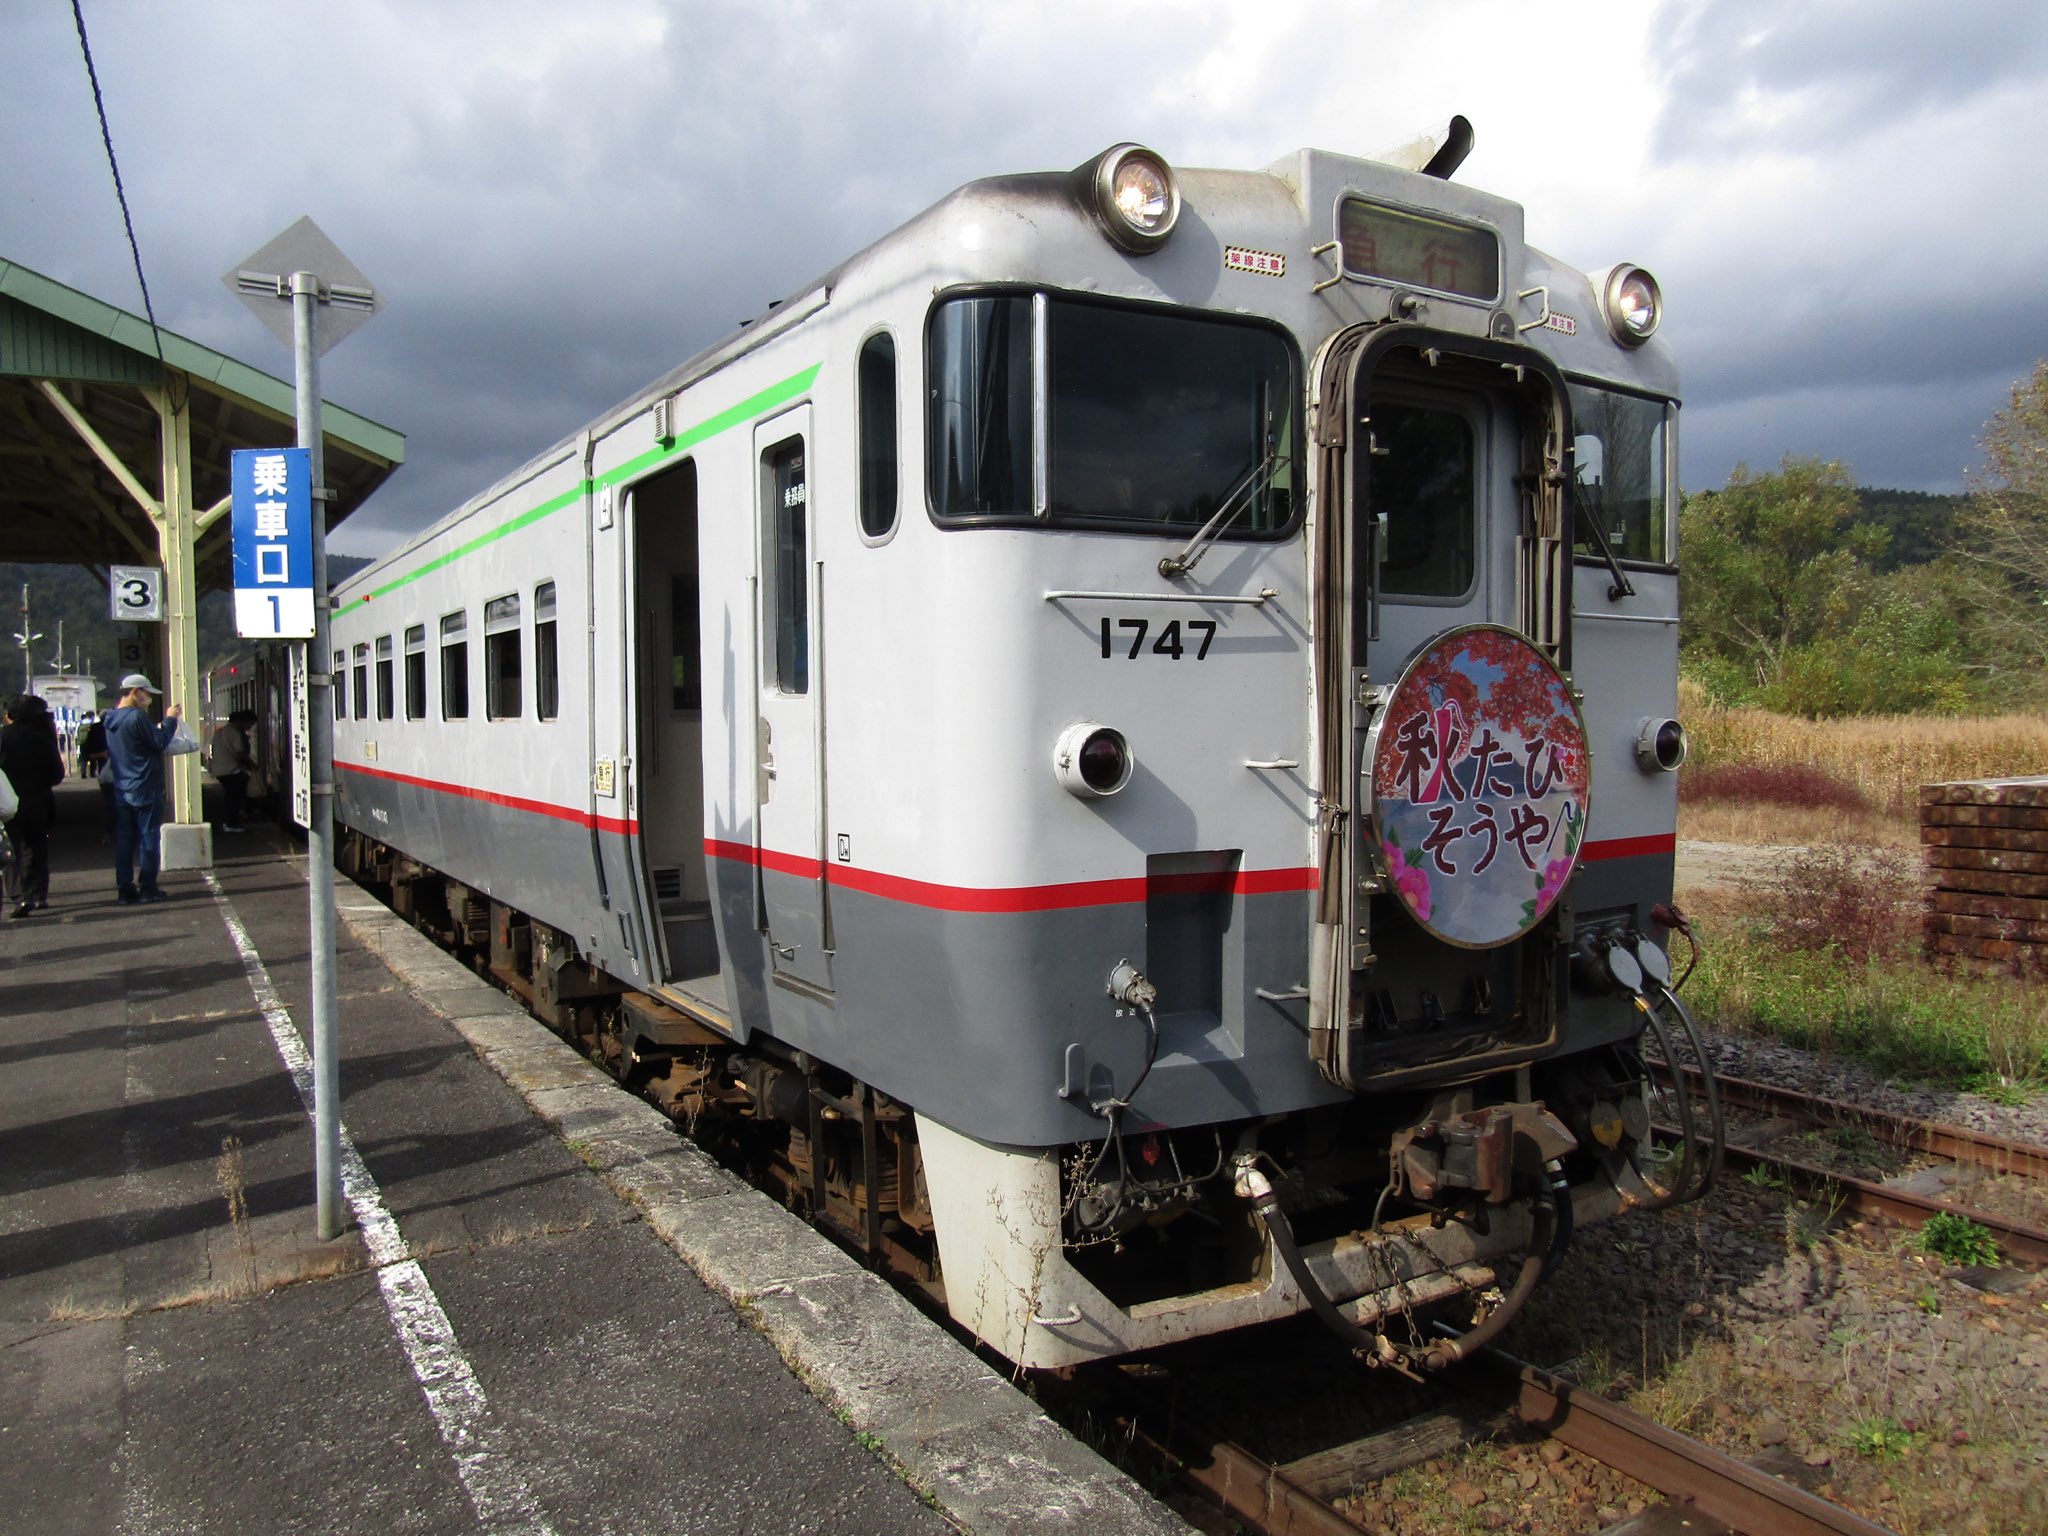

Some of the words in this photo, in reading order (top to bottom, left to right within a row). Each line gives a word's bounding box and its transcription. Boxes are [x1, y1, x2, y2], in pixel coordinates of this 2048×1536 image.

[1231, 253, 1279, 271] 架線注意
[254, 455, 289, 584] 乗車口
[123, 579, 151, 608] 3
[267, 595, 281, 634] 1
[125, 644, 140, 661] 3
[1101, 618, 1216, 660] 1747
[1396, 702, 1573, 803] 秋たび
[1423, 804, 1550, 875] そうや
